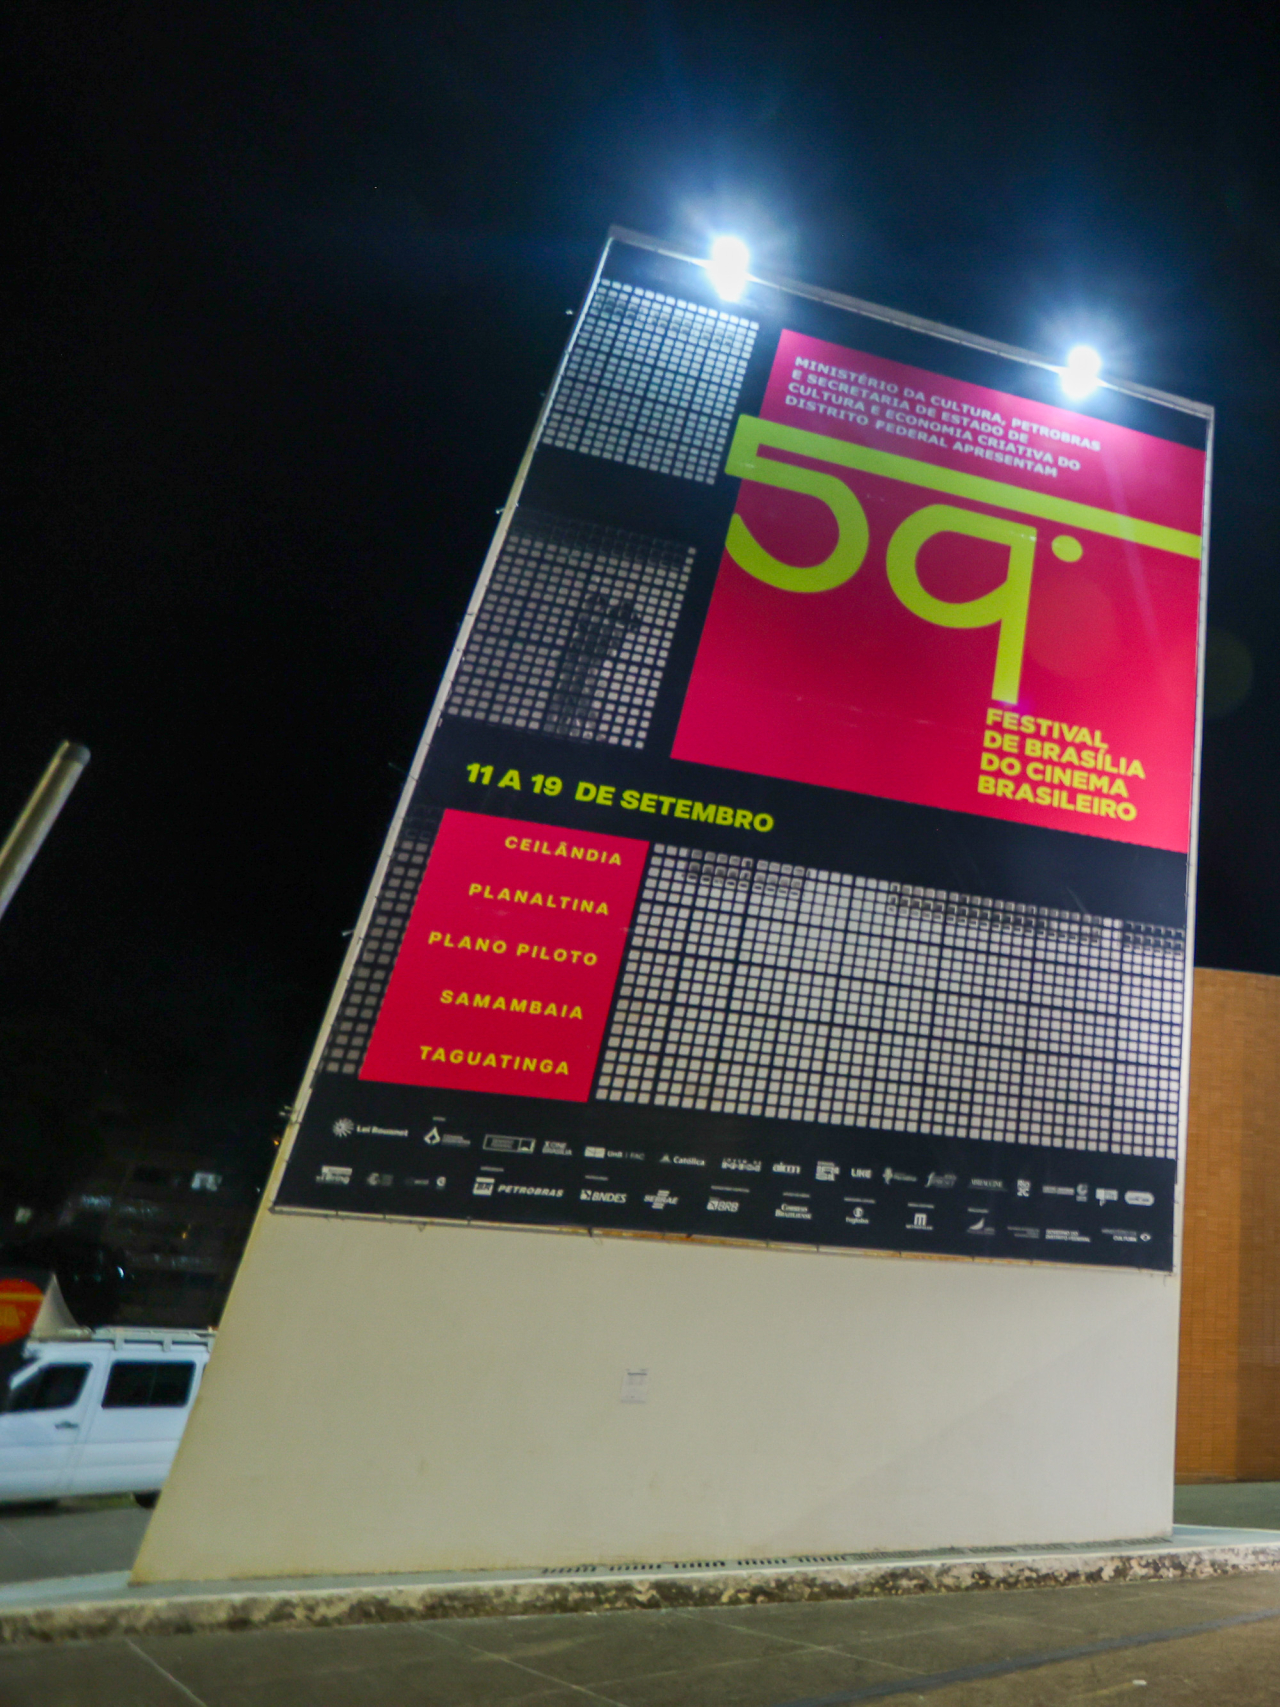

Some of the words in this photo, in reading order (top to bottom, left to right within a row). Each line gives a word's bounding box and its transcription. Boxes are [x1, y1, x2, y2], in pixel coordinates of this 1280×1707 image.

[788, 382, 865, 412] CULTURA
[870, 405, 881, 416] E
[885, 409, 973, 442] ECONOMIA
[977, 435, 1054, 464] CRIATIVA
[1057, 455, 1081, 471] DO
[791, 369, 803, 381] E
[806, 373, 910, 411] SECRETARIA
[915, 404, 937, 418] DE
[940, 411, 1004, 437] ESTADO
[1007, 429, 1030, 445] DE
[795, 356, 899, 394] MINISTÉRIO
[903, 388, 926, 402] DA
[930, 395, 1006, 426] CULTURA,
[1011, 417, 1101, 452] PETROBRAS
[785, 394, 869, 426] DISTRITO
[875, 419, 948, 449] FEDERAL
[952, 441, 1058, 478] APRESENTAM
[985, 707, 1109, 750] FESTIVAL
[980, 751, 1022, 777] DO
[1025, 761, 1130, 799] CINEMA
[982, 729, 1021, 754] DE
[1024, 737, 1146, 780] BRASÍLIA
[466, 762, 494, 786] 11
[497, 768, 522, 791] A
[531, 773, 563, 797] 19
[574, 781, 616, 806] DE
[620, 788, 776, 833] SETEMBRO
[977, 774, 1138, 822] BRASILEIRO
[504, 835, 622, 866] CEILÂNDIA
[468, 882, 610, 916] PLANALTINA
[428, 930, 508, 955] PLANO
[516, 942, 598, 967] PILOTO
[439, 988, 584, 1021] SAMAMBAIA
[419, 1044, 570, 1077] TAGUATINGA
[497, 1184, 564, 1198] PETROBRAS
[592, 1191, 627, 1204] BNDES
